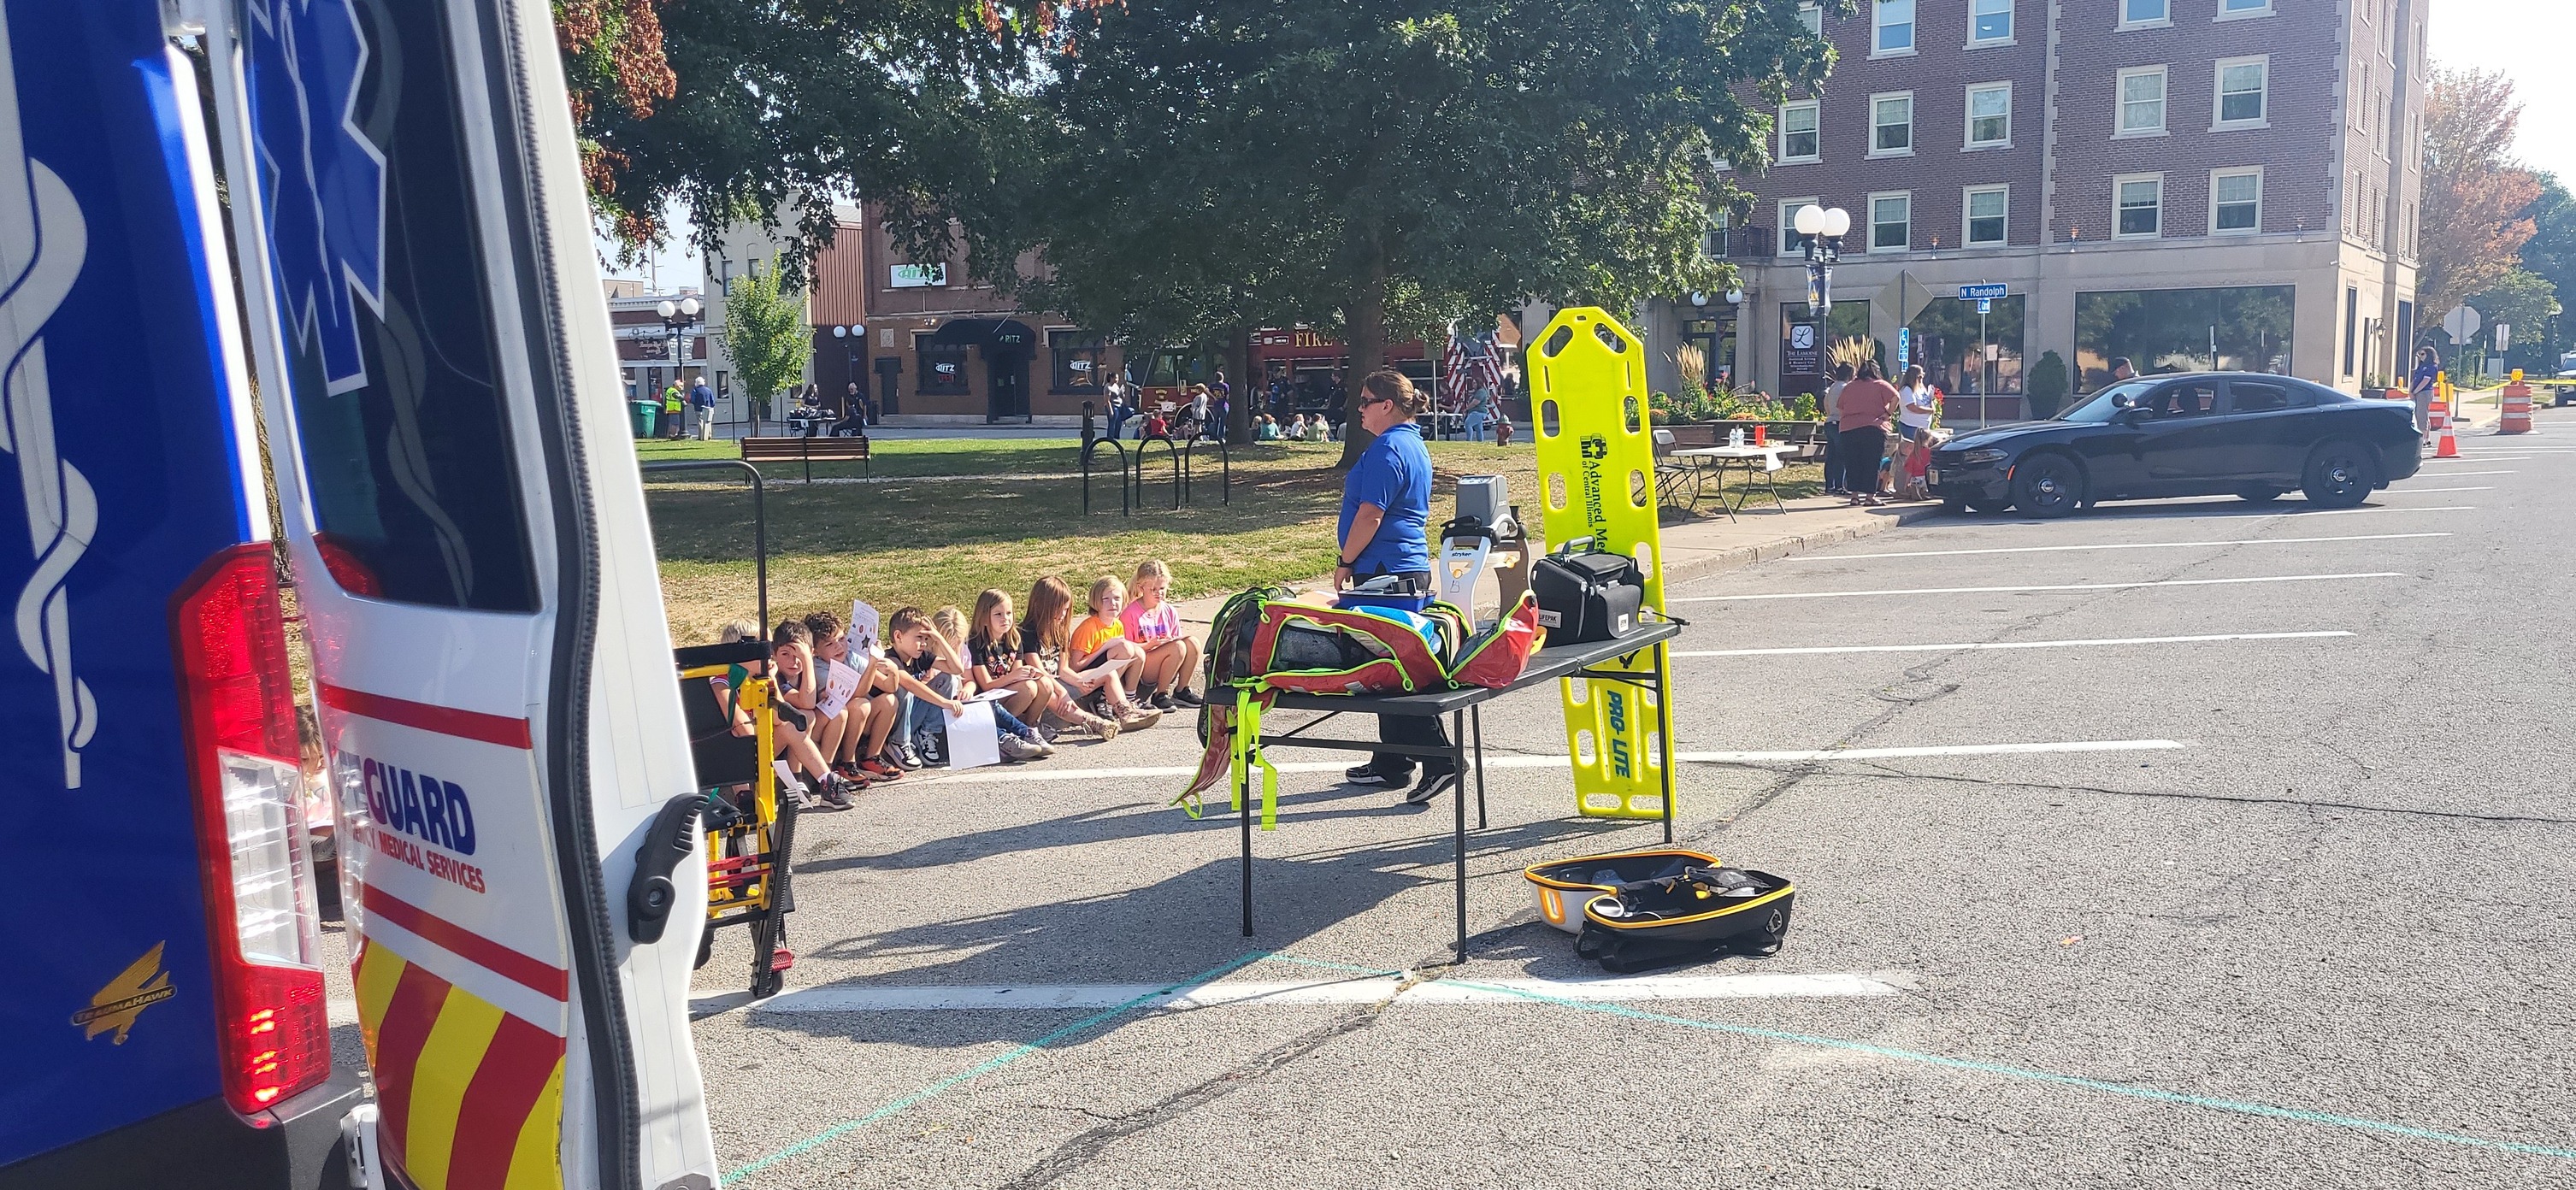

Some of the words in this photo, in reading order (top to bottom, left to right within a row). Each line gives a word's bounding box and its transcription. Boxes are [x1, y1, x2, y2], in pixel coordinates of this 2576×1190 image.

[1961, 287, 1967, 298] N
[1970, 286, 2005, 298] Randolph
[1005, 334, 1021, 343] RITZ
[1583, 470, 1593, 498] Central
[1589, 461, 1606, 523] Advanced
[1612, 739, 1630, 778] LITE
[378, 830, 425, 871] MEDICAL
[426, 850, 486, 894] SERVICES
